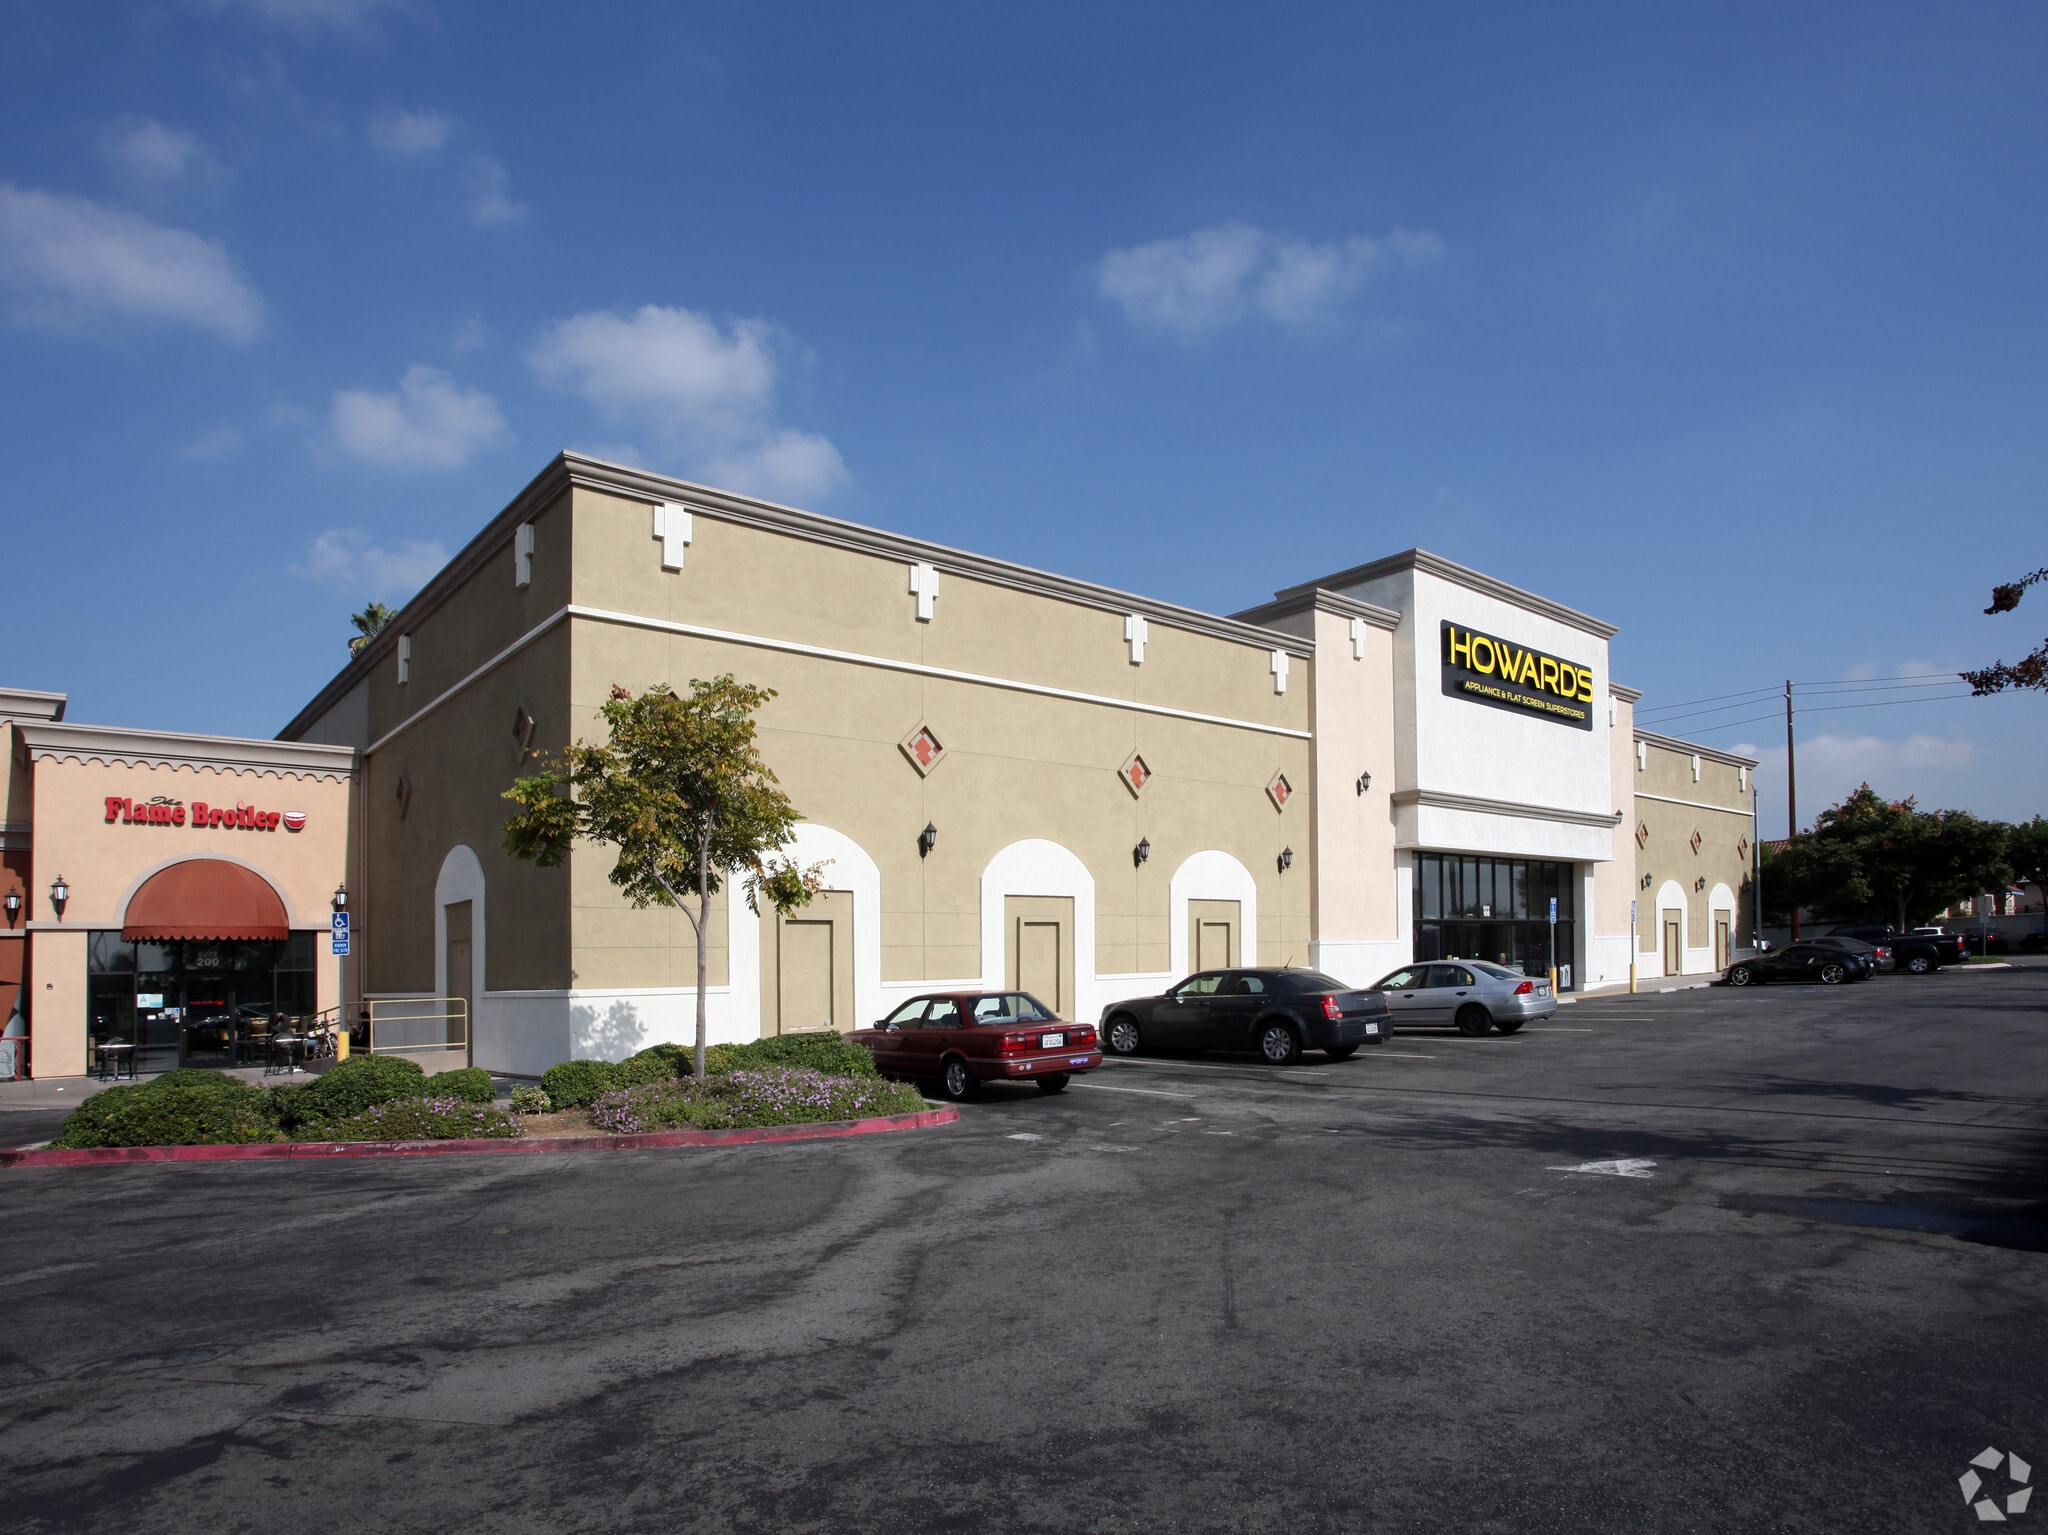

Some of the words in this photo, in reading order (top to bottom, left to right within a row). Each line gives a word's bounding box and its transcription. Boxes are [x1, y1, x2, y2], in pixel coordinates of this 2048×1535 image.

[1450, 627, 1593, 704] HOWARD'S
[1465, 681, 1501, 697] APPLIANCE
[1507, 692, 1522, 703] FLAT
[1522, 696, 1545, 709] SCREEN
[1546, 702, 1585, 719] SUPERSTORES
[105, 797, 187, 826] Flame
[192, 800, 281, 830] Broiler
[145, 796, 184, 806] The
[196, 958, 220, 966] 200
